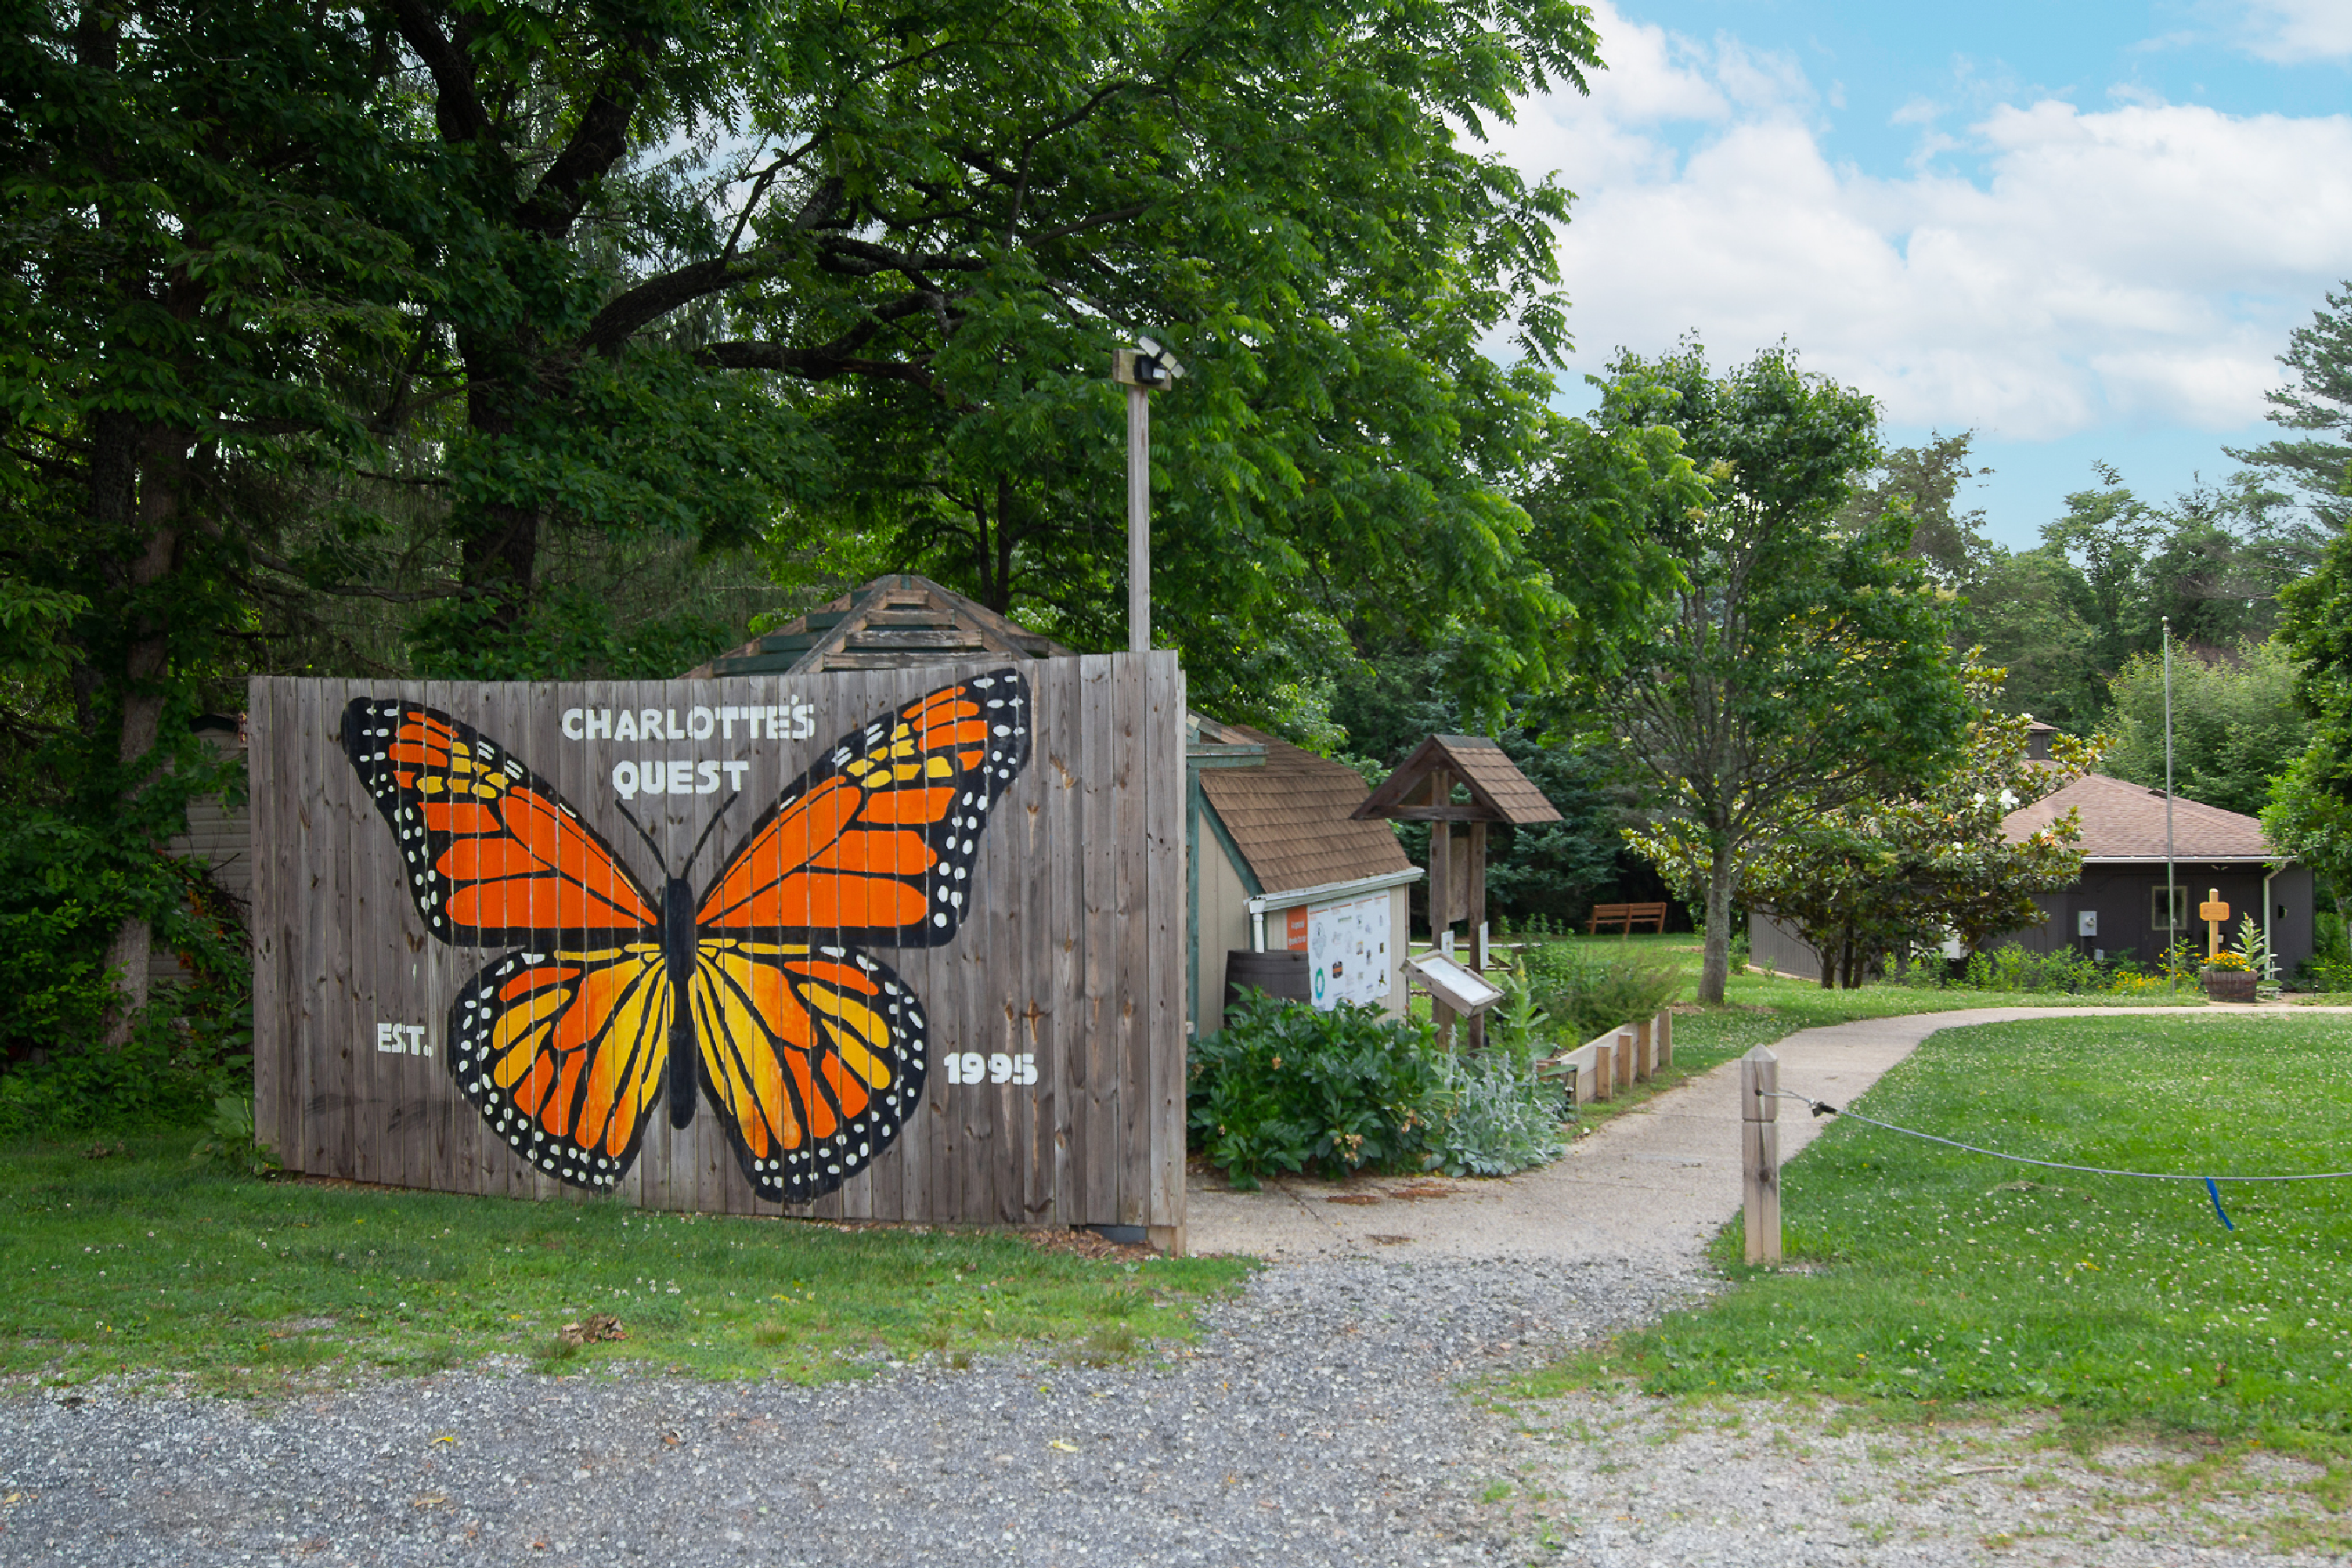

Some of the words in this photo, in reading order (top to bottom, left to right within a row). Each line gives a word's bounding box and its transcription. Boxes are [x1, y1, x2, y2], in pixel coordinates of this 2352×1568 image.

[561, 694, 814, 740] CHARLOTTE'S
[612, 760, 749, 800] QUEST
[377, 1023, 433, 1058] EST.
[943, 1052, 1038, 1085] 1995
